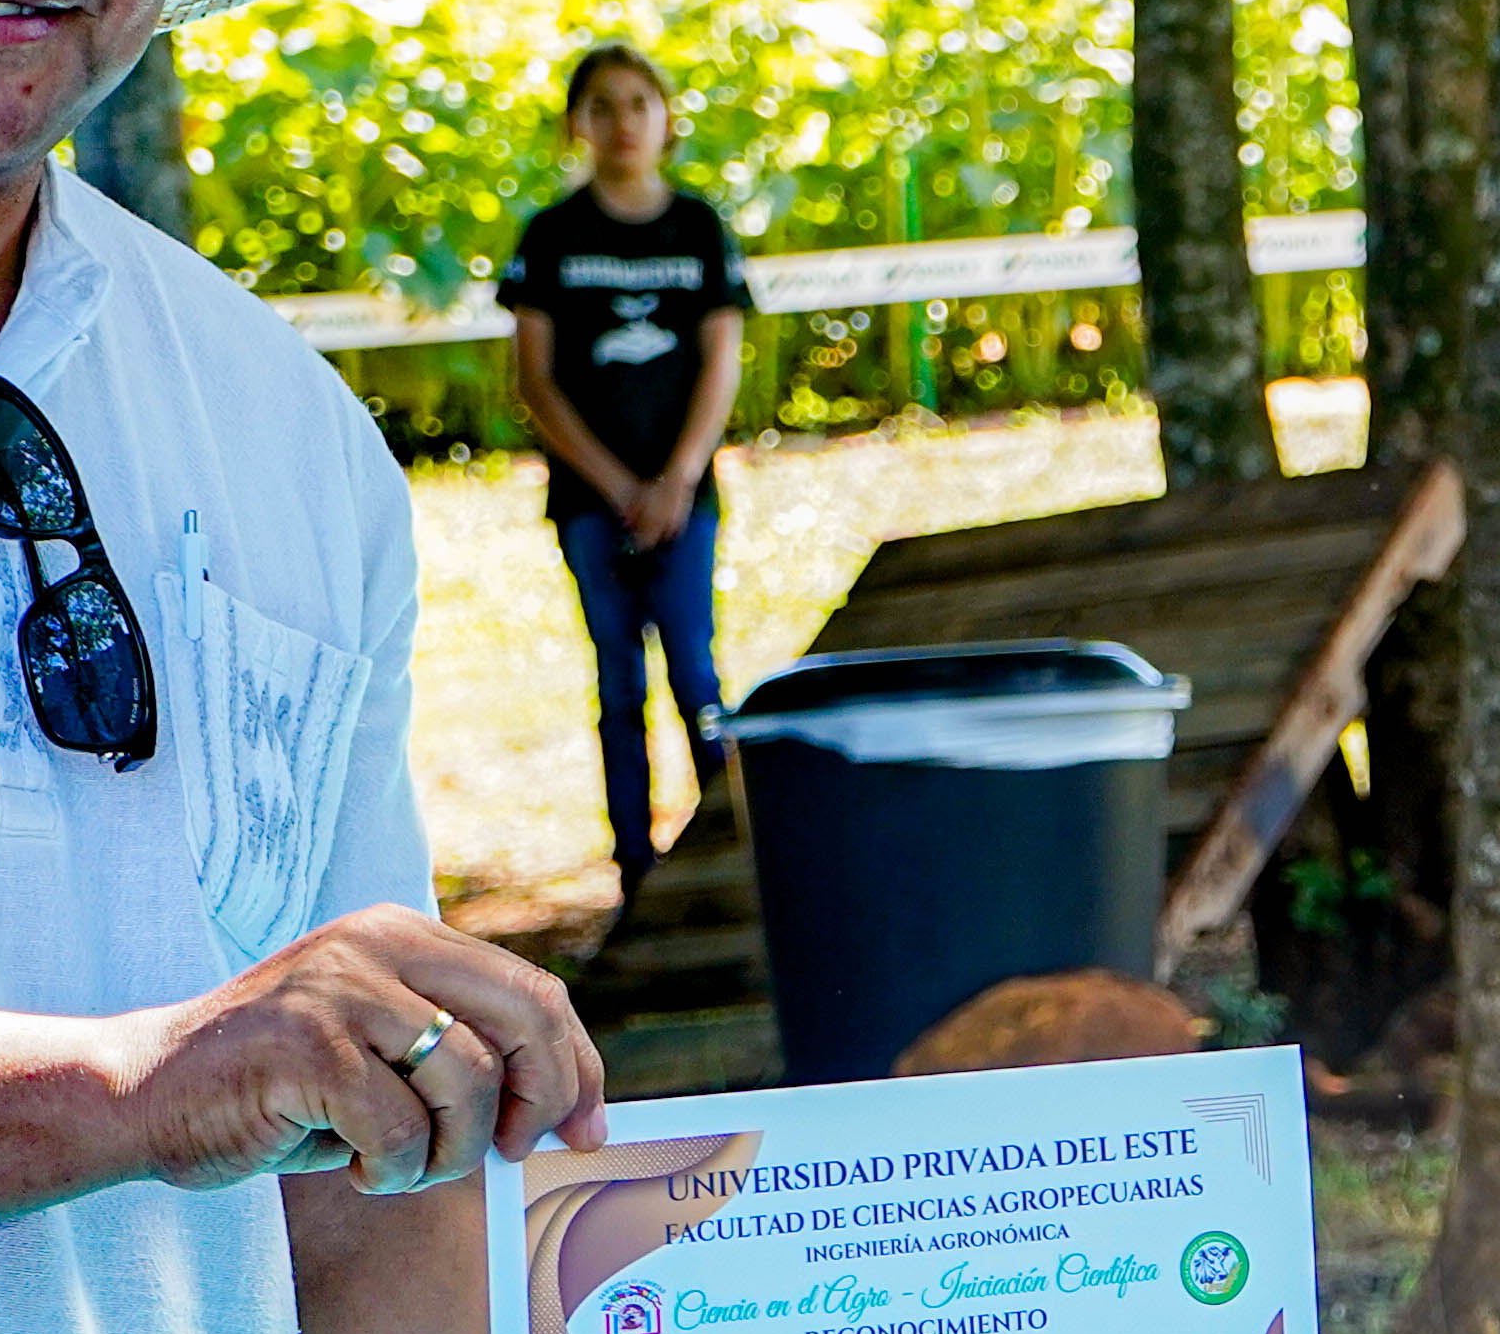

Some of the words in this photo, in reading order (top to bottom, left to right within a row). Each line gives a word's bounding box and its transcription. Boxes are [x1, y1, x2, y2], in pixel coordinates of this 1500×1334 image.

[667, 1155, 894, 1201] UNIVERSIDAD
[903, 1144, 1046, 1180] PRIVADA
[1053, 1136, 1117, 1166] DEL
[1124, 1128, 1198, 1160] ESTE
[665, 1211, 804, 1245] FACULTAD
[811, 1208, 847, 1231] DE
[852, 1195, 977, 1227] CIENCIAS
[983, 1174, 1204, 1216] AGROPECUARIAS
[805, 1233, 924, 1263] INGENIERÍA
[928, 1223, 1070, 1251] AGRONÓMICA
[673, 1289, 759, 1331] Ciencia
[765, 1302, 791, 1318] en
[797, 1284, 819, 1315] el
[823, 1274, 891, 1323] Agro
[921, 1261, 1049, 1308] Iniciación
[1056, 1252, 1161, 1298] Científica
